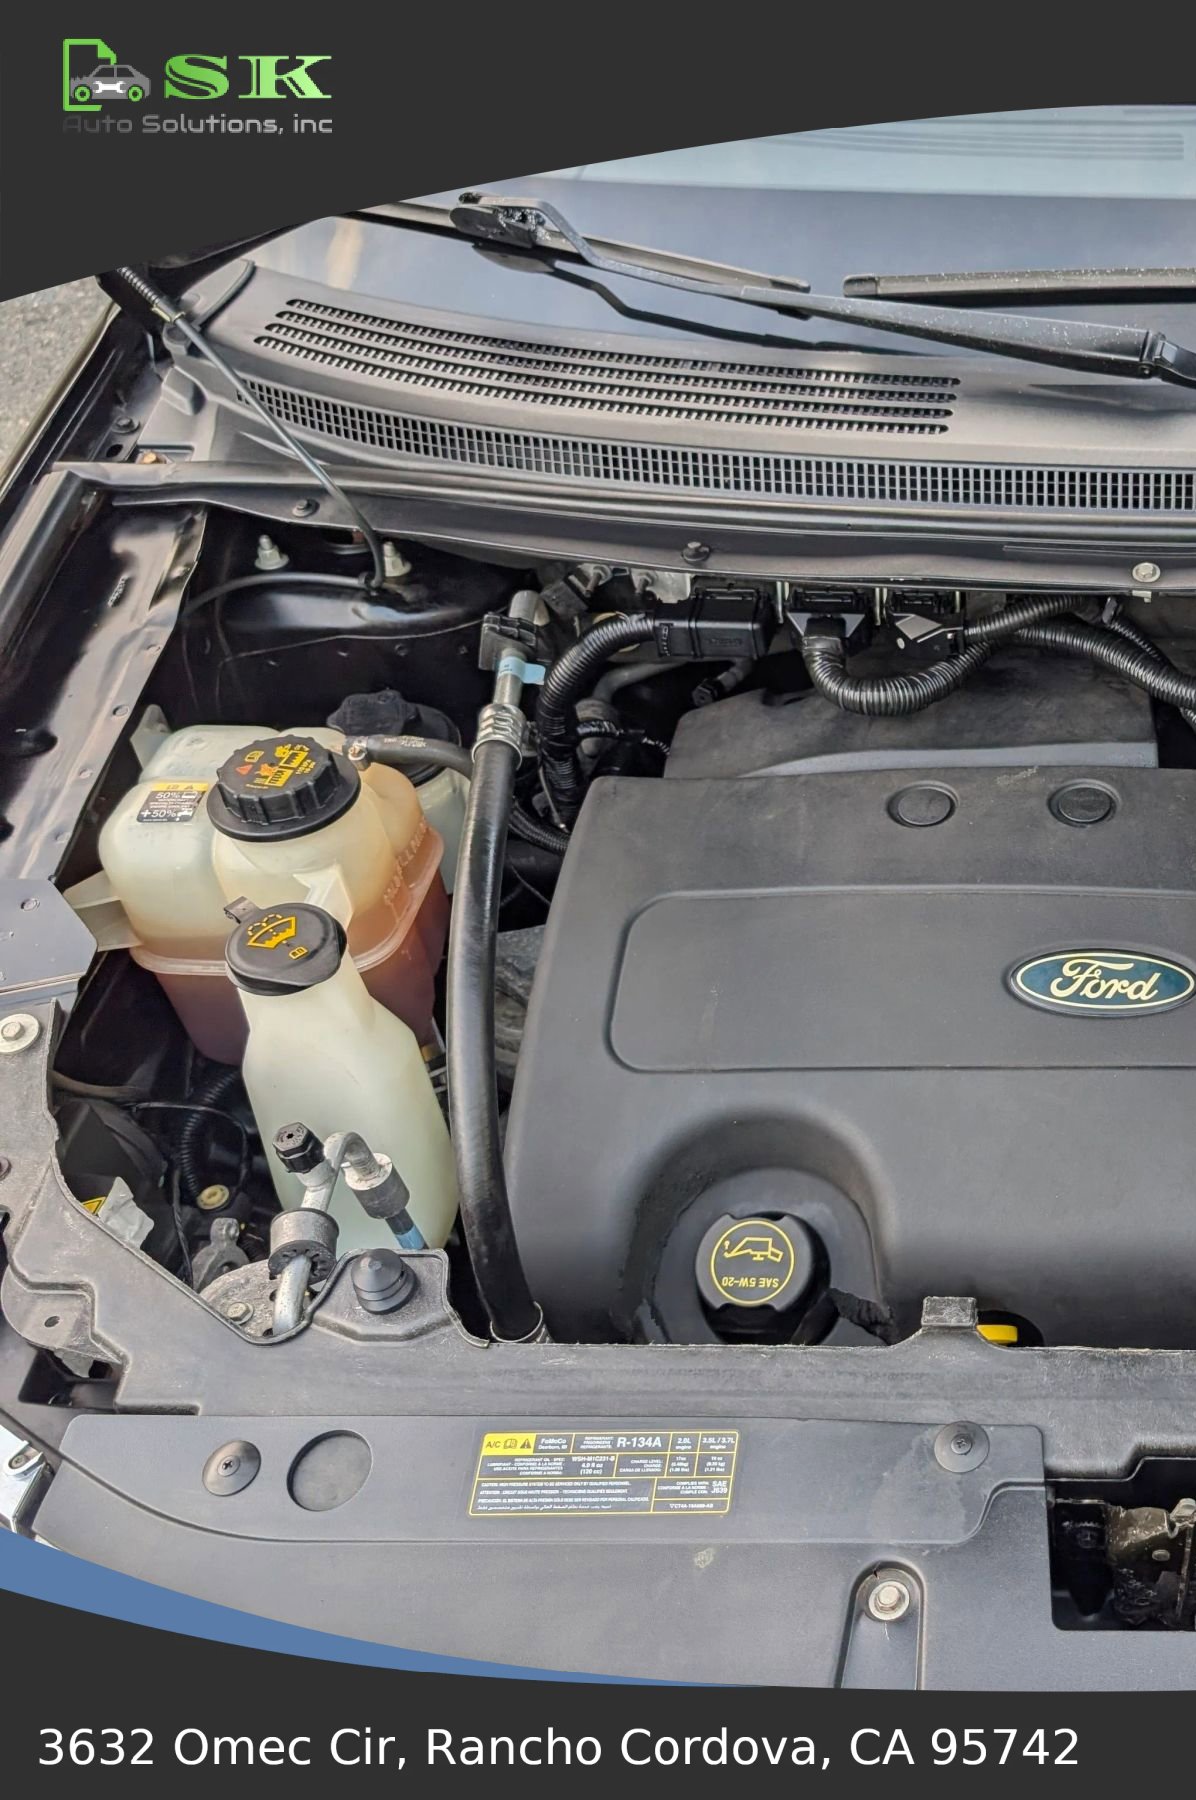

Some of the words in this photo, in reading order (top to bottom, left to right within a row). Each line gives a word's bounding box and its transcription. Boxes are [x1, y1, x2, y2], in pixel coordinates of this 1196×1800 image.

[1050, 958, 1162, 1001] Ford
[721, 1276, 756, 1288] 5W-20
[758, 1277, 779, 1288] SAE
[486, 1440, 501, 1449] A/C
[617, 1436, 662, 1448] R-134A
